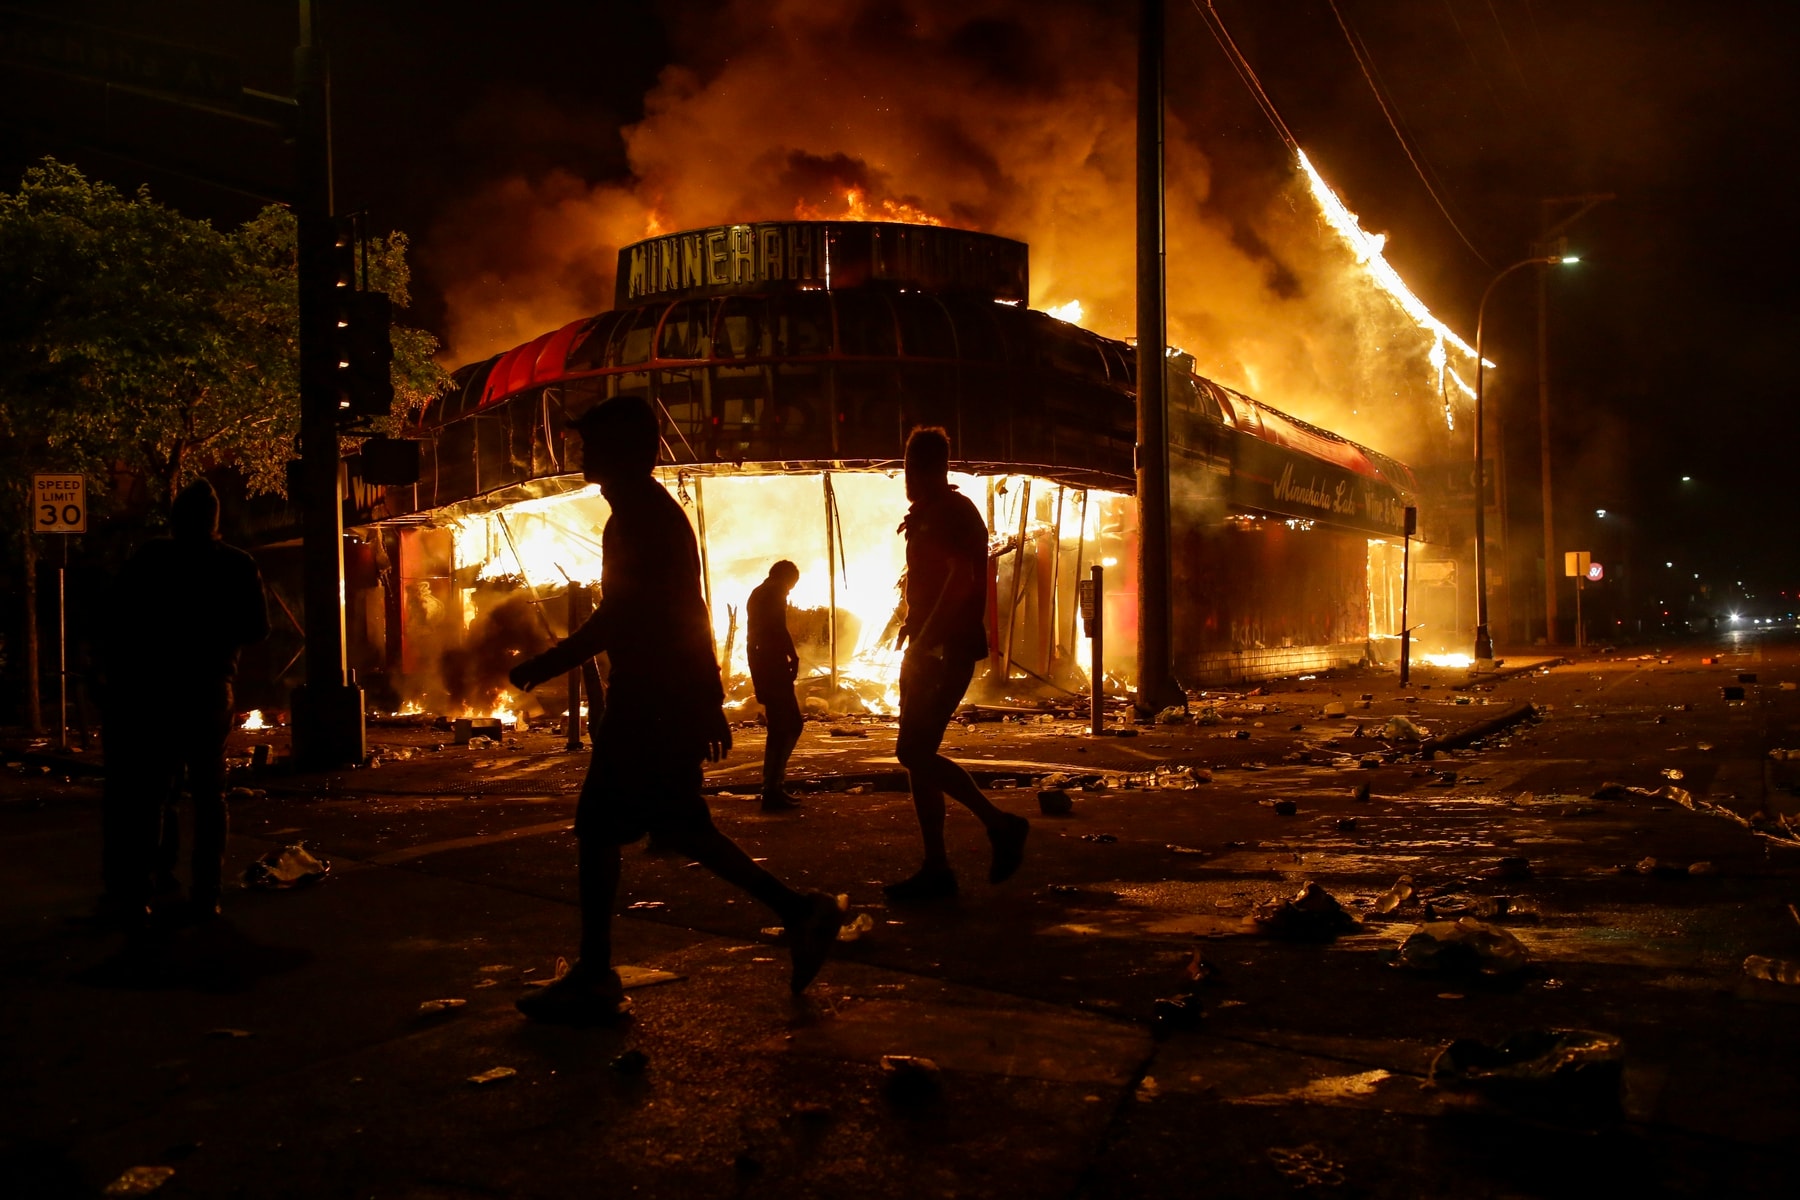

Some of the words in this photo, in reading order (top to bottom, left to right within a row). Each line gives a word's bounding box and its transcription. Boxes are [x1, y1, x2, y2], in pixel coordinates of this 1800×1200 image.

[37, 480, 80, 489] SPEED
[1273, 461, 1332, 510] Minnehaha
[42, 492, 76, 502] LIMIT
[39, 504, 81, 525] 30
